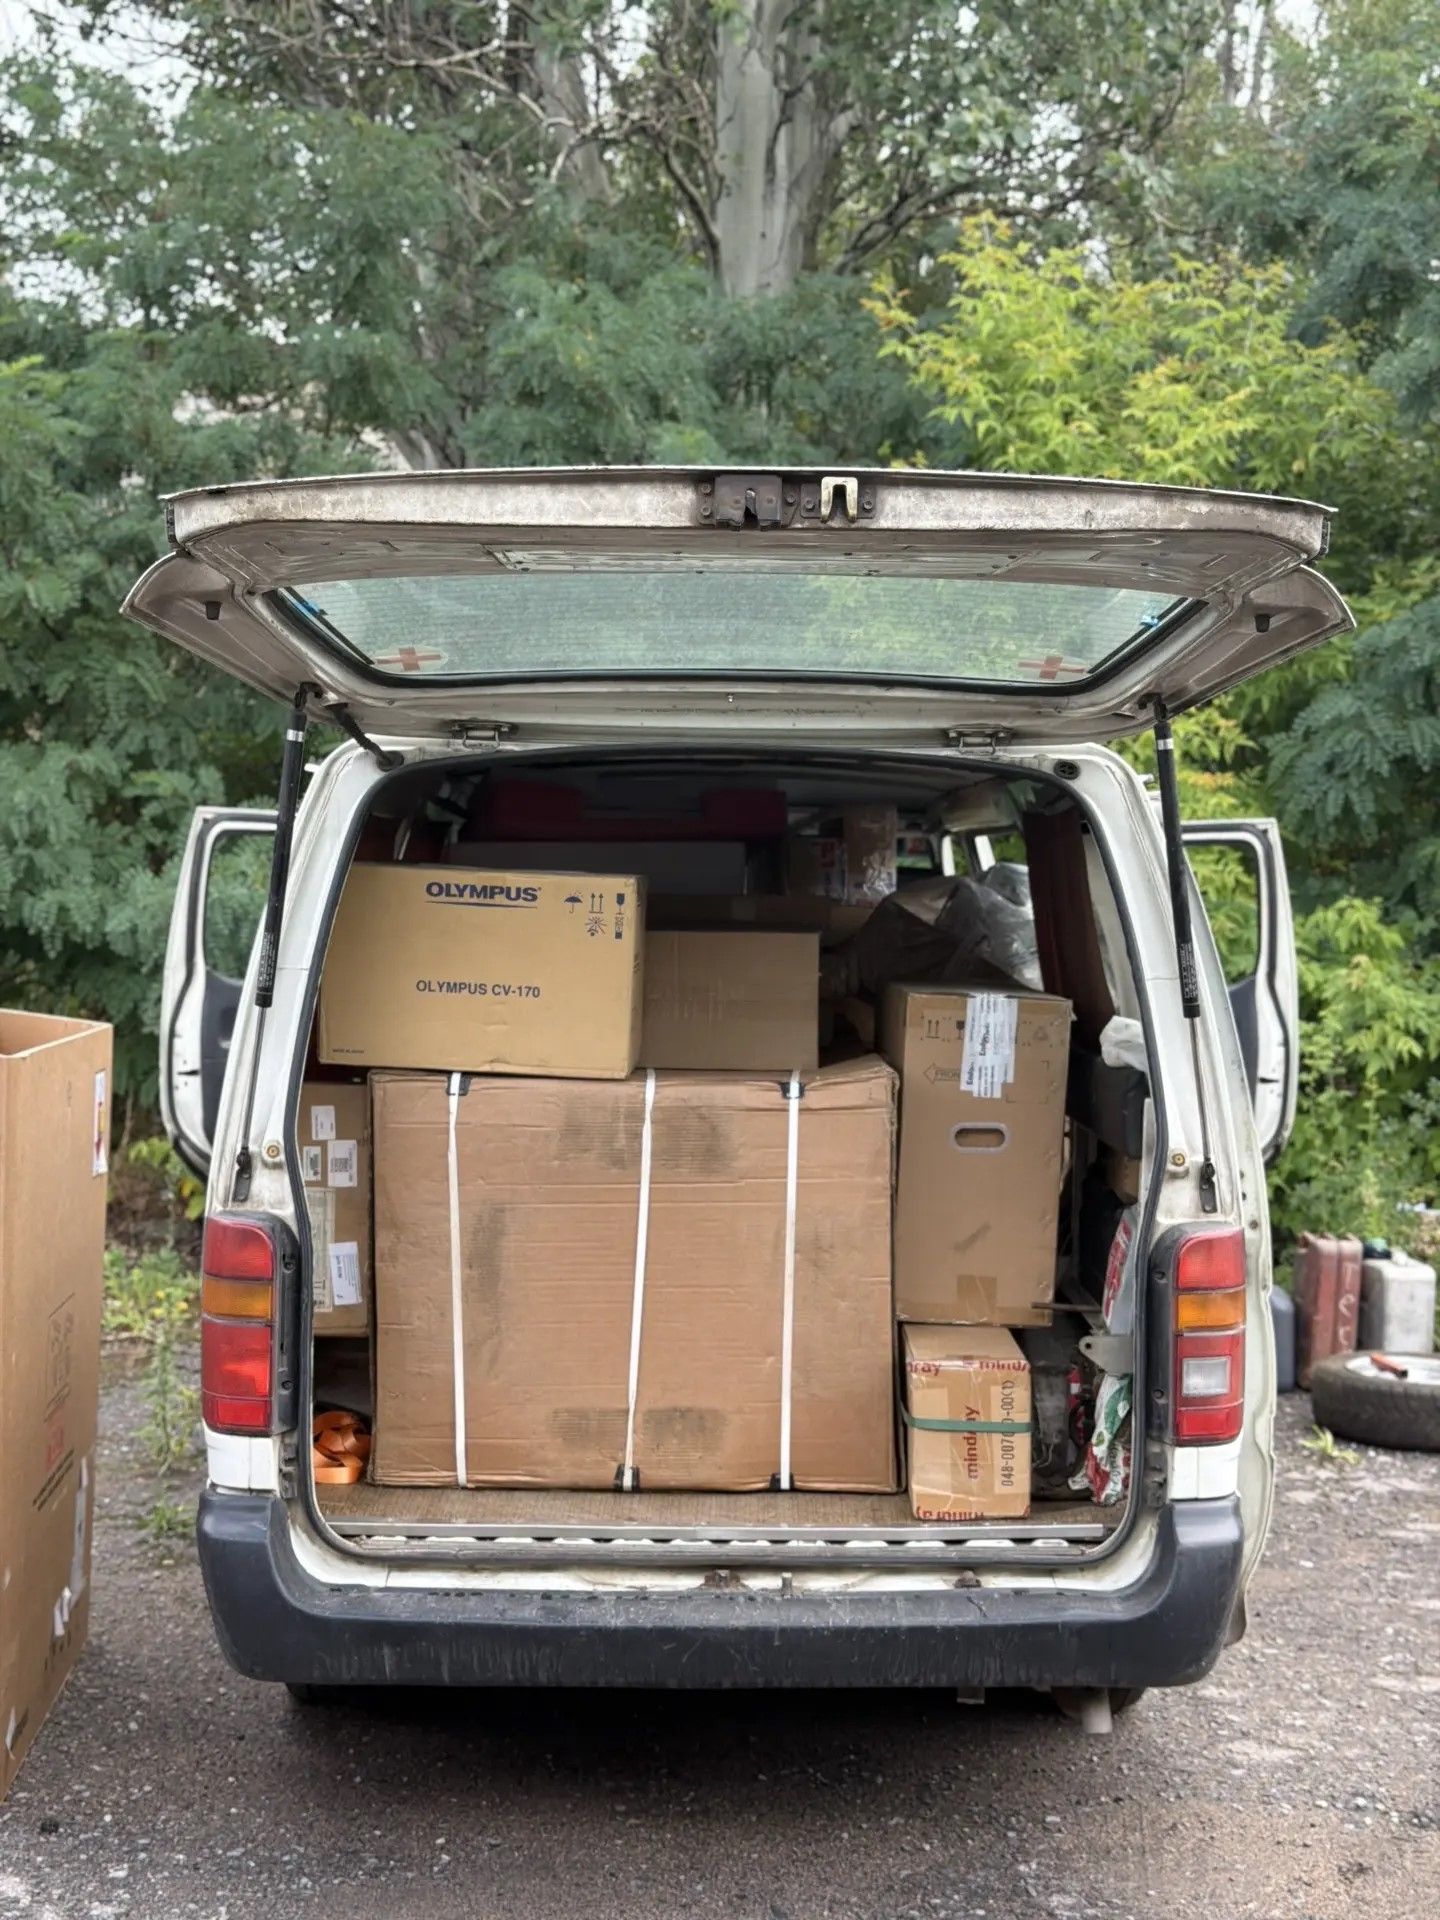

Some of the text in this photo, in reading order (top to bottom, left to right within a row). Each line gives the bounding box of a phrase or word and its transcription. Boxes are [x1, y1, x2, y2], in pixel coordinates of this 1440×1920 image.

[426, 882, 538, 902] OLYMPUS
[416, 980, 540, 998] OLYMPUS CV-170
[962, 1404, 980, 1480] mindy
